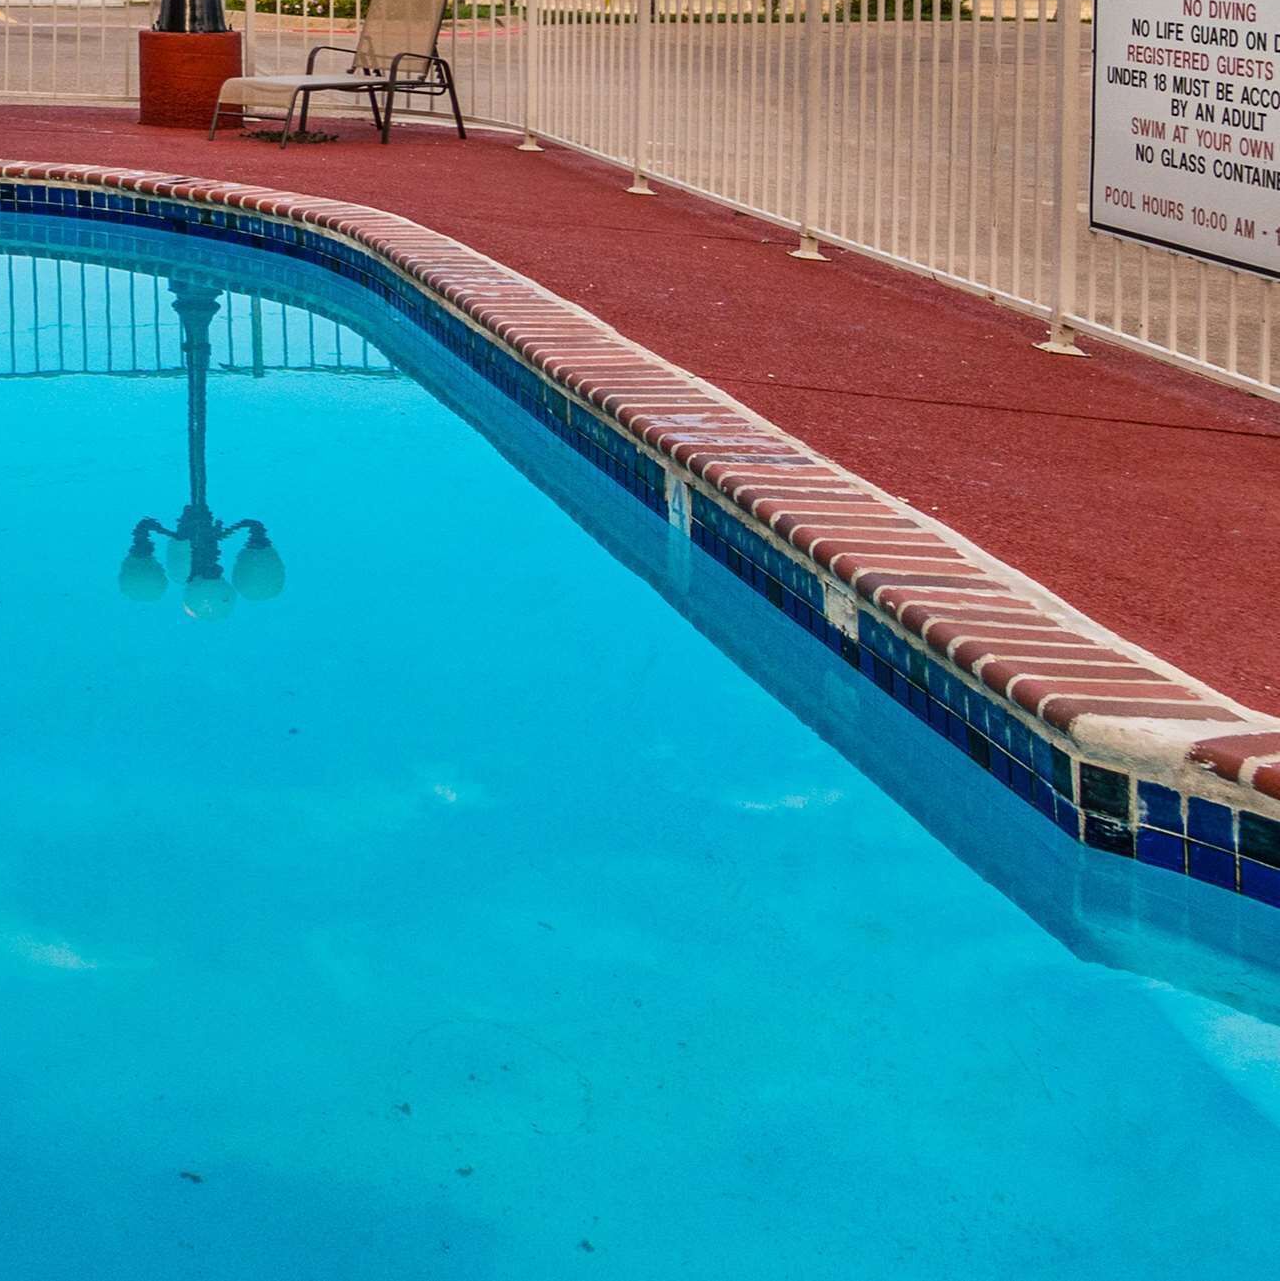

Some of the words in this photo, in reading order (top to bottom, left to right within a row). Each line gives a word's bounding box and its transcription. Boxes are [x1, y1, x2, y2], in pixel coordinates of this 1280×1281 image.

[1209, 0, 1257, 23] DIVING
[1132, 18, 1150, 38] NO
[1156, 21, 1184, 42] LIFE
[1191, 25, 1239, 48] GUARD
[1246, 31, 1267, 52] ON
[1127, 44, 1210, 72] REGISTERED
[1217, 56, 1274, 81] GUESTS
[1107, 66, 1147, 89] UNDER
[1154, 73, 1167, 92] 18
[1172, 76, 1210, 99] MUST
[1216, 82, 1234, 102] BE
[1241, 86, 1280, 111] ACCO
[1171, 98, 1188, 118] BY
[1196, 103, 1215, 123] AN
[1221, 107, 1267, 132] ADULT
[1131, 116, 1166, 140] SWIM
[1172, 125, 1189, 144] AT
[1196, 129, 1232, 153] YOUR
[1239, 137, 1274, 161] OWN
[1136, 143, 1154, 164] NO
[1161, 149, 1206, 175] GLASS
[1105, 186, 1136, 210] POOL
[1142, 194, 1185, 222] HOURS
[1191, 206, 1227, 232] 10:00
[1234, 217, 1255, 240] AM
